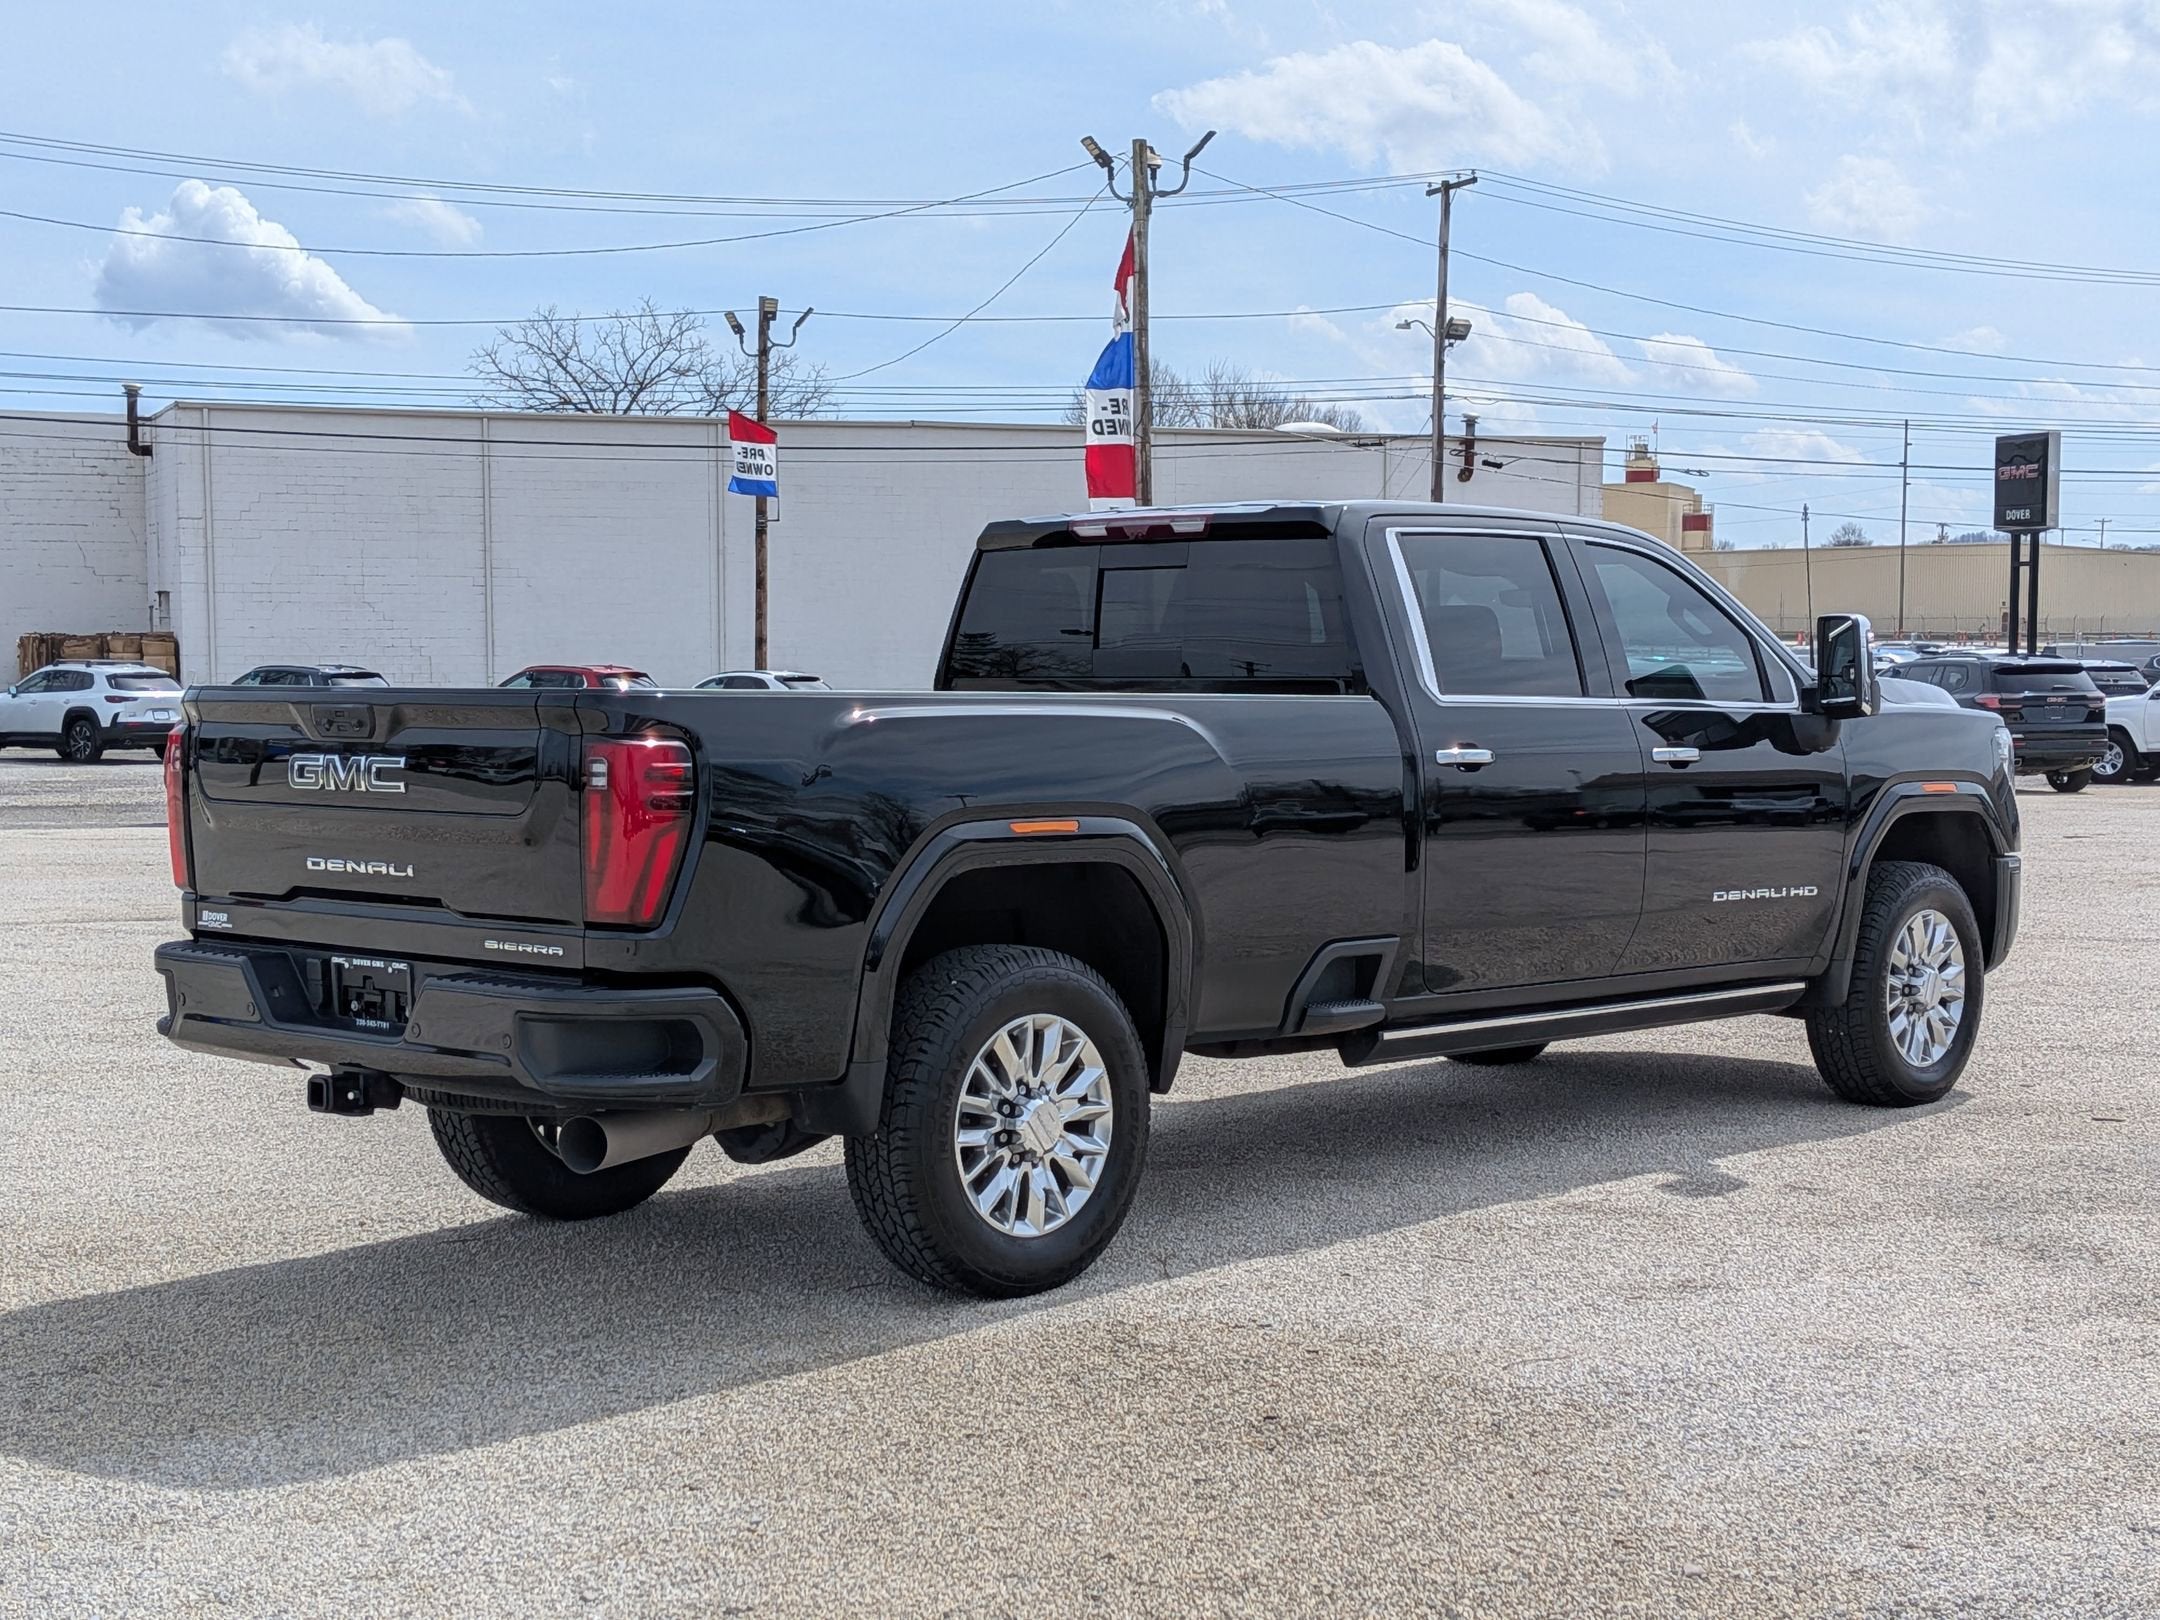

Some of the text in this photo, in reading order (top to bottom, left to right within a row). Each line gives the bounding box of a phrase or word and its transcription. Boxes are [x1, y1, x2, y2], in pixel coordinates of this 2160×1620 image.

[1998, 464, 2039, 480] GMC
[2006, 509, 2031, 520] DOVER
[288, 753, 406, 793] GMC
[306, 857, 414, 877] DENALI
[1712, 886, 1818, 902] DENALI HD
[484, 940, 564, 956] SIERRA
